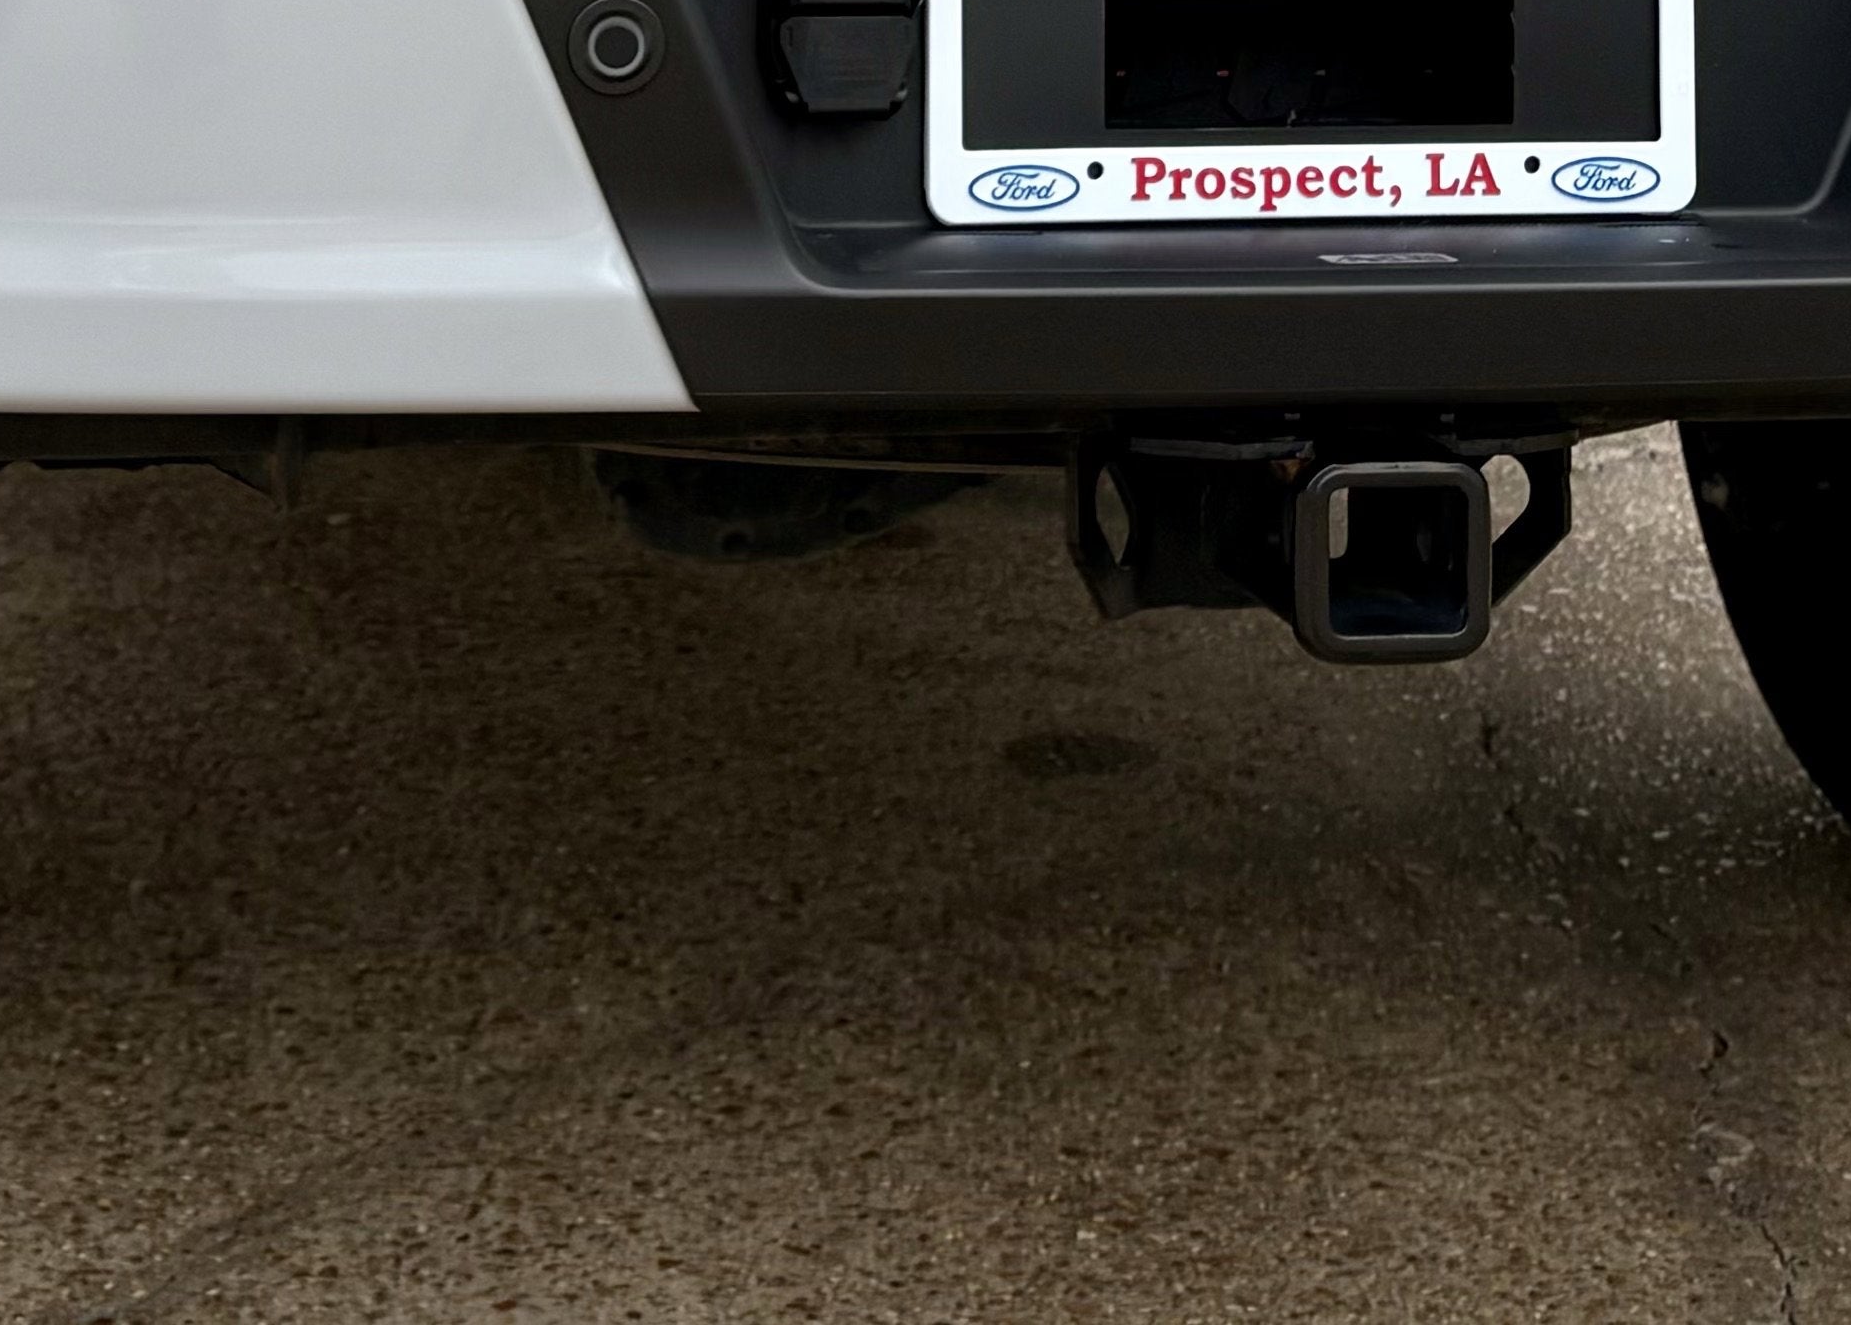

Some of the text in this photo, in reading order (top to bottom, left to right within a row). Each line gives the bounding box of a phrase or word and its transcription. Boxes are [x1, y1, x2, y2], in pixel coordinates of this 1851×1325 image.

[990, 170, 1056, 204] Ford
[1130, 153, 1501, 211] Prospect, LA
[1574, 162, 1638, 194] Ford
